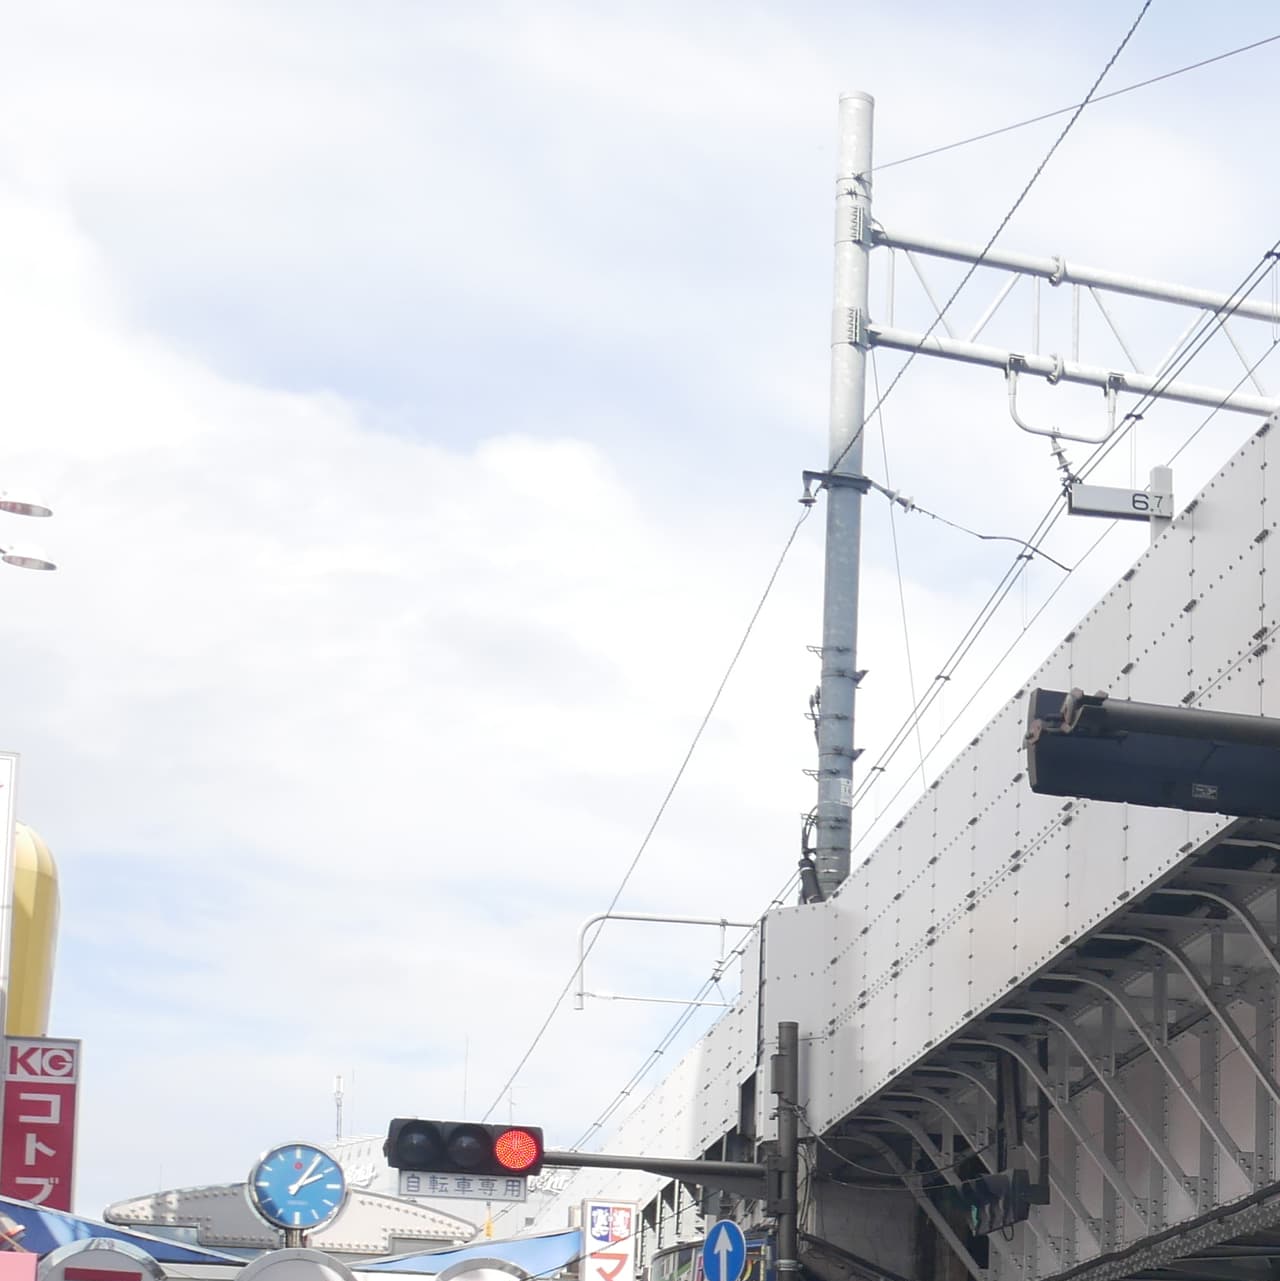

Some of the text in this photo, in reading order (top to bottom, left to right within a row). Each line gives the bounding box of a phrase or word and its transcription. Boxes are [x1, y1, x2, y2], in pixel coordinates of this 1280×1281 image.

[9, 1046, 74, 1077] KG
[406, 1173, 521, 1197] 自転車専用
